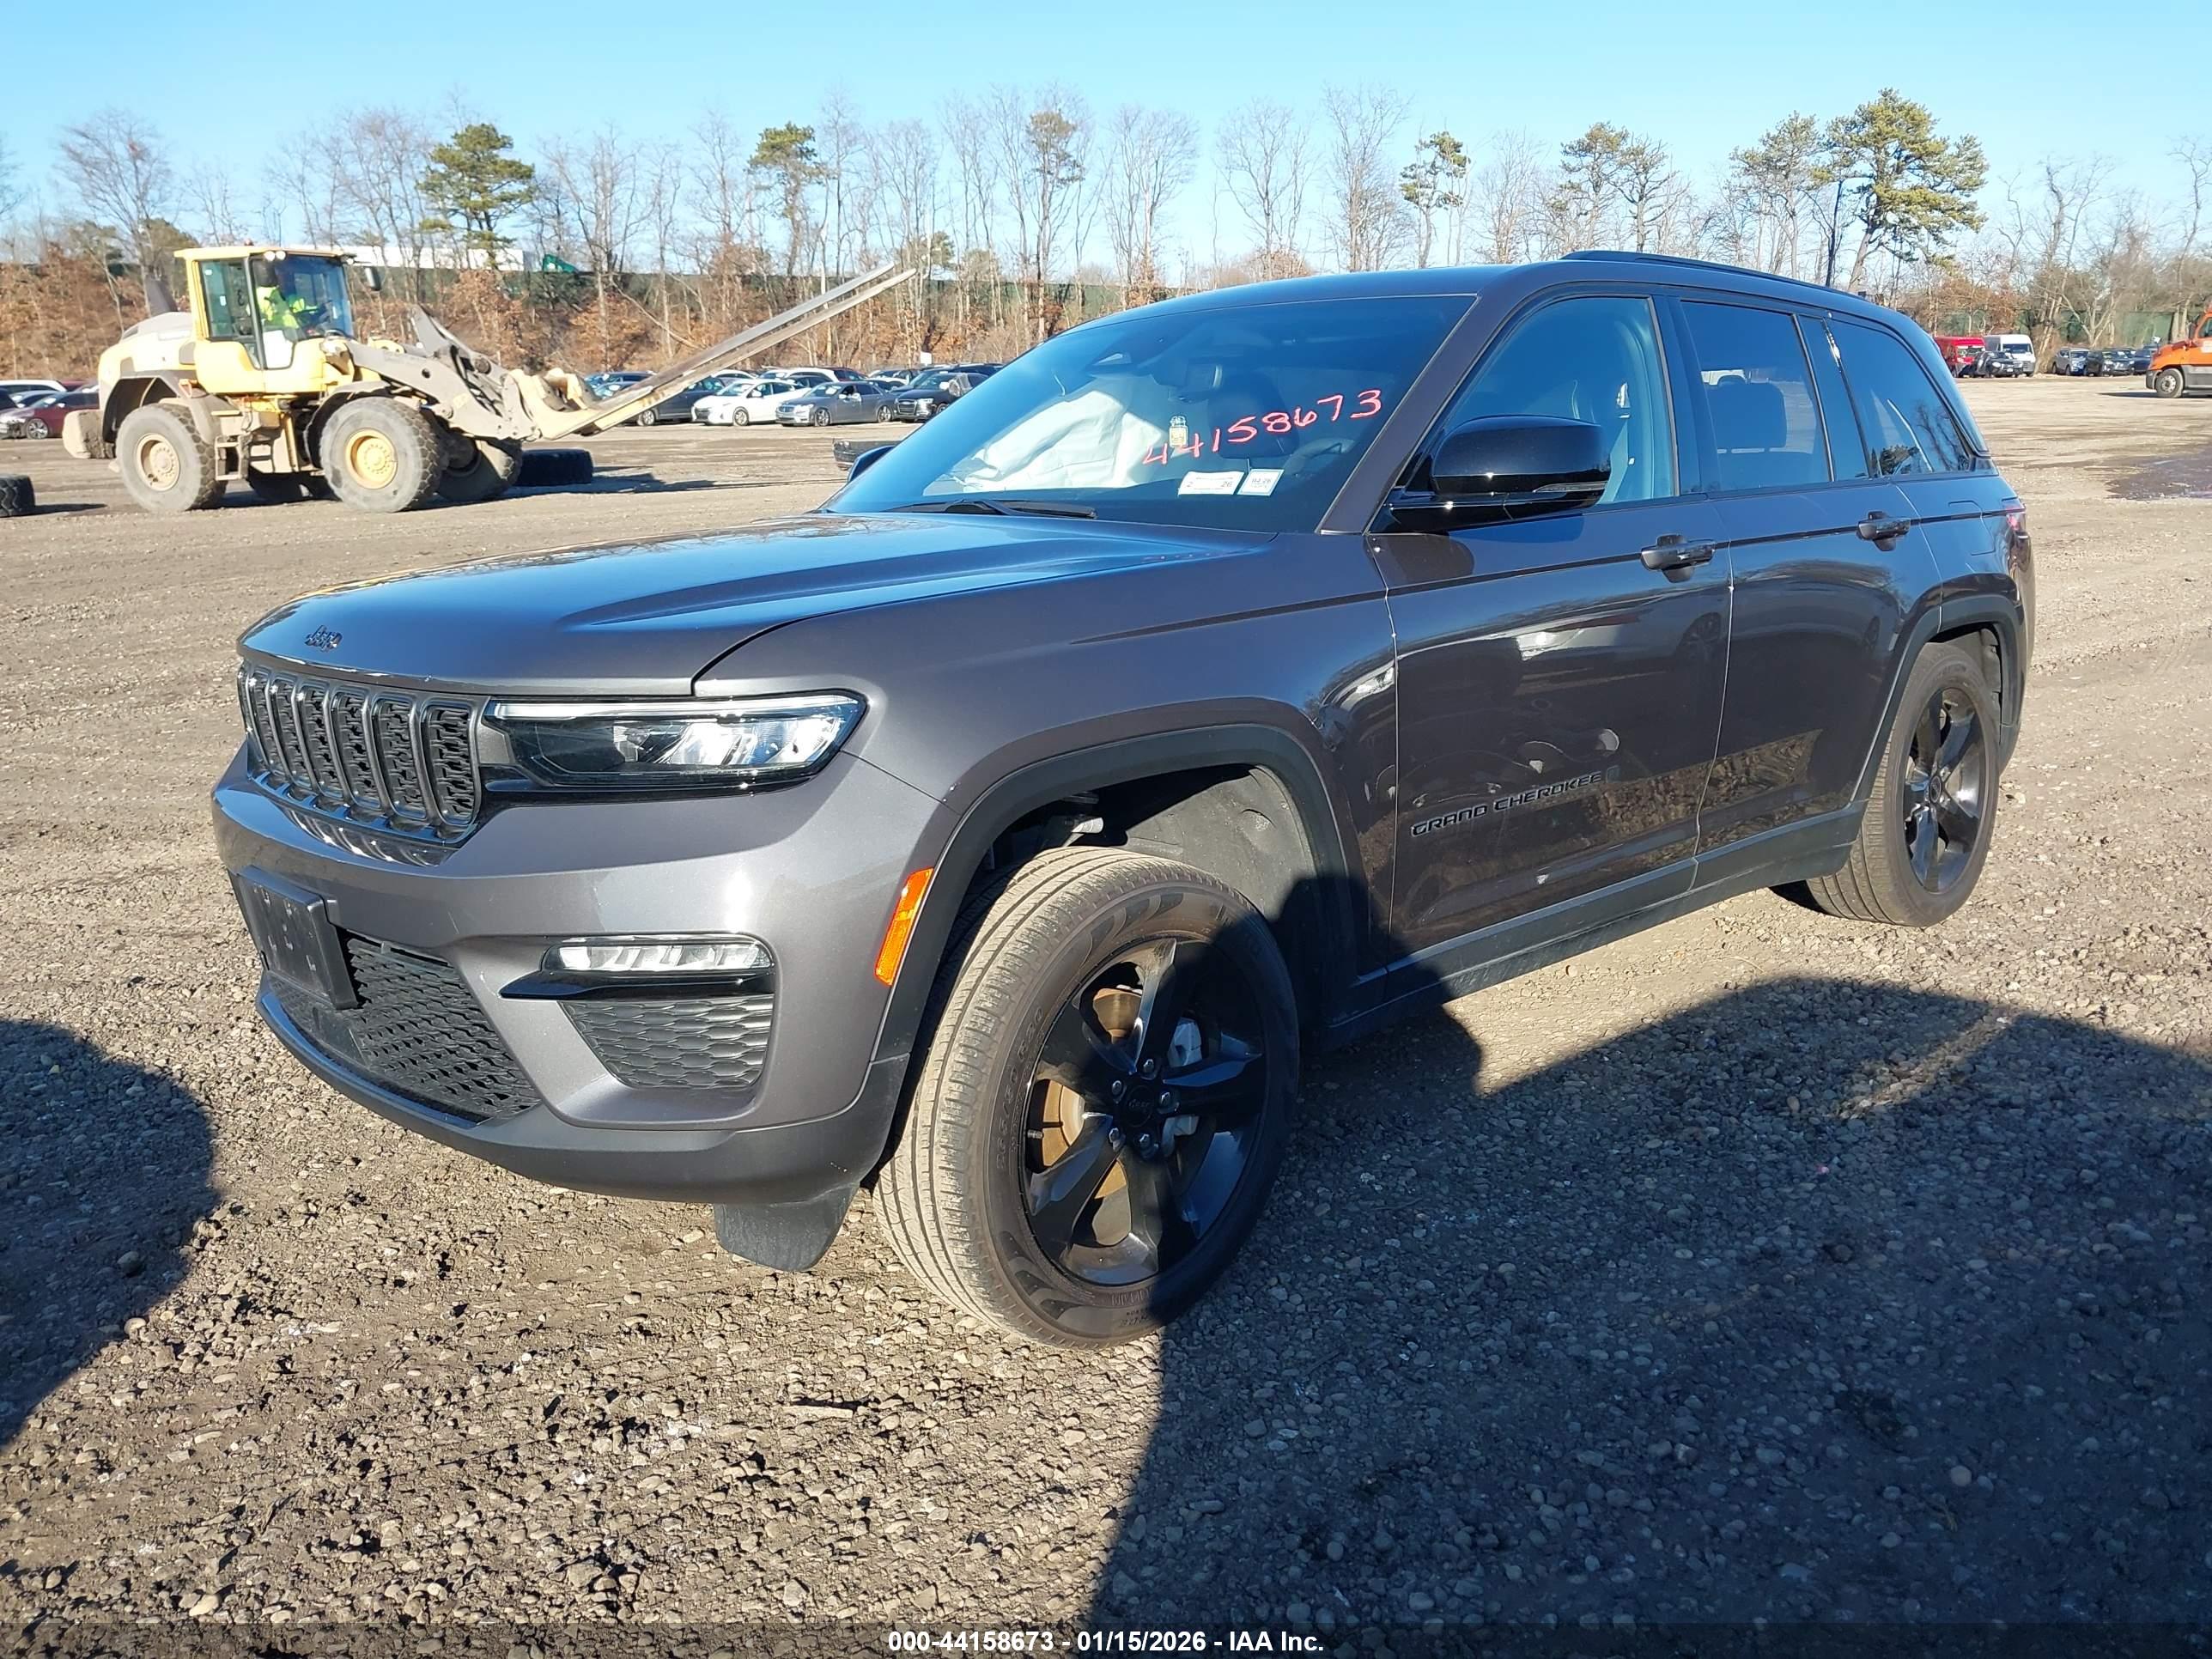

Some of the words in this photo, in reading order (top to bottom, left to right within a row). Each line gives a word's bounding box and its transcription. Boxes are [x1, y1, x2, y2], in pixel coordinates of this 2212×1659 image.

[1142, 389, 1382, 465] 44158673
[1411, 804, 1488, 837] GRAND
[1492, 771, 1601, 813] CHEROKEE
